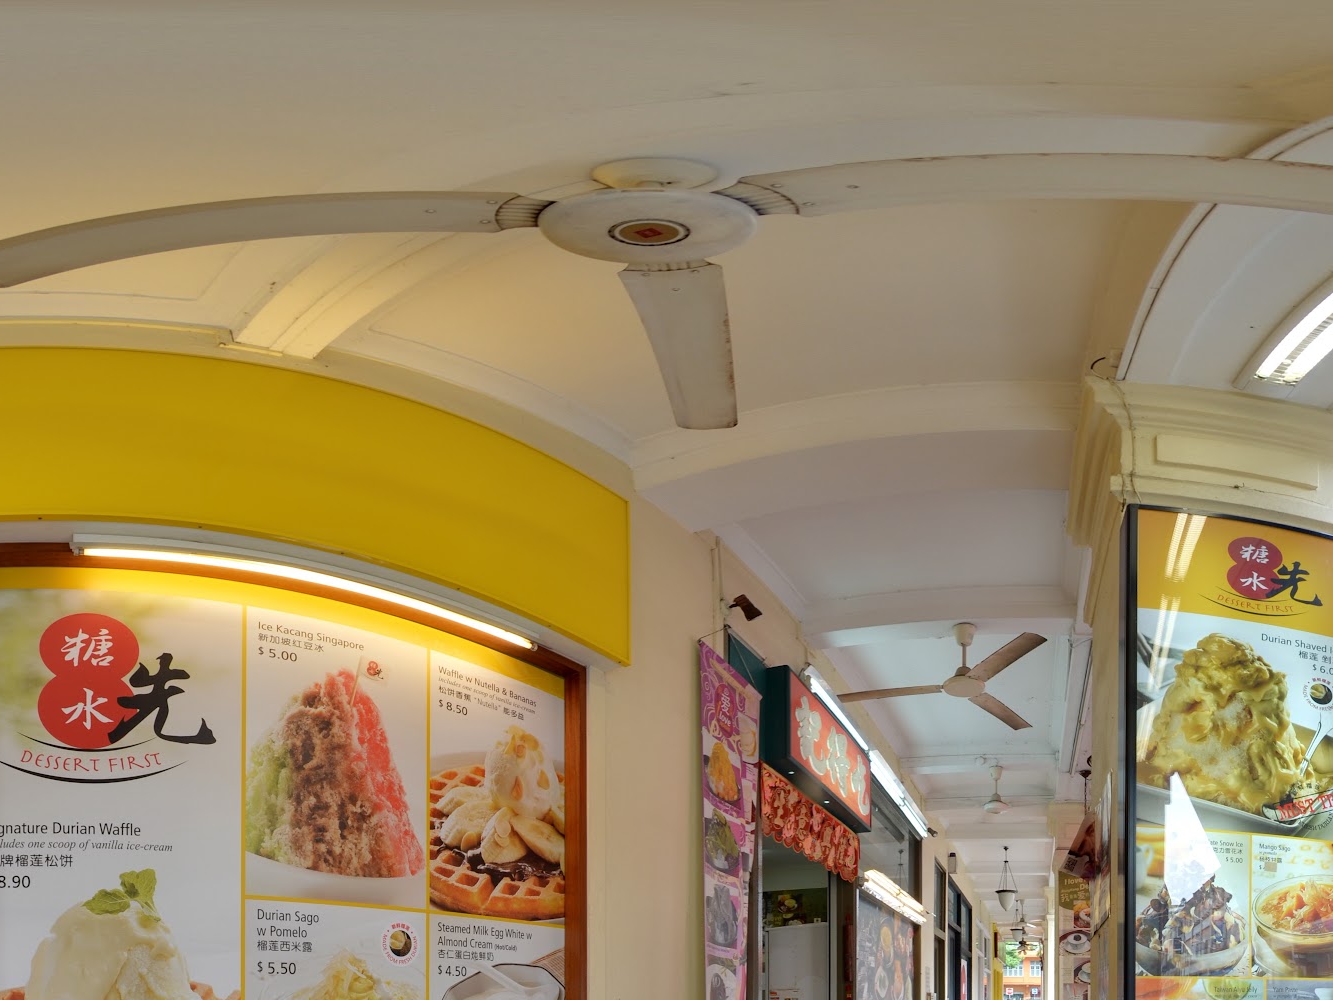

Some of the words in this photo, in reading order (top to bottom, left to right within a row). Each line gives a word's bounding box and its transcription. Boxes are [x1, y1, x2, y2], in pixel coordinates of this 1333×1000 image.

[1239, 544, 1269, 592] 糖水
[1265, 561, 1323, 607] 先
[1217, 594, 1263, 613] DESSERT
[1265, 603, 1295, 613] FIRST
[257, 621, 274, 633] Ice
[275, 624, 314, 644] Kacang
[316, 632, 365, 653] Singapore
[257, 632, 325, 653] 新加坡红豆冰
[1261, 633, 1292, 646] Durian
[1295, 639, 1327, 653] Shaved
[60, 628, 115, 730] 糖水
[438, 665, 464, 680] Waffle
[474, 678, 500, 693] Nutella
[501, 687, 507, 695] &
[509, 690, 537, 707] Bananas
[108, 652, 216, 745] 先
[438, 677, 461, 688] includes
[473, 687, 488, 697] scoop
[513, 700, 535, 714] ice-cream
[20, 750, 100, 772] DESSERT
[108, 752, 162, 773] FIRST
[1276, 798, 1315, 821] MUST
[52, 821, 96, 835] Durian
[99, 822, 141, 836] Waffle
[27, 841, 46, 850] one
[48, 841, 76, 852] scoop
[79, 839, 91, 852] of
[91, 839, 124, 851] vanilla
[126, 840, 173, 852] ice-cream
[1259, 843, 1277, 851] Mango
[1278, 845, 1291, 853] Sago
[257, 908, 291, 922] Durian
[294, 910, 319, 926] Sago
[270, 925, 308, 938] Pomelo
[437, 922, 471, 934] Steamed
[473, 925, 489, 936] Milk
[491, 927, 504, 939] Egg
[504, 929, 525, 940] White
[256, 940, 313, 953] 榴莲西米露
[437, 936, 468, 948] Almond
[469, 938, 493, 950] Cream
[437, 949, 494, 961] 杏仁蛋白炖鲜奶
